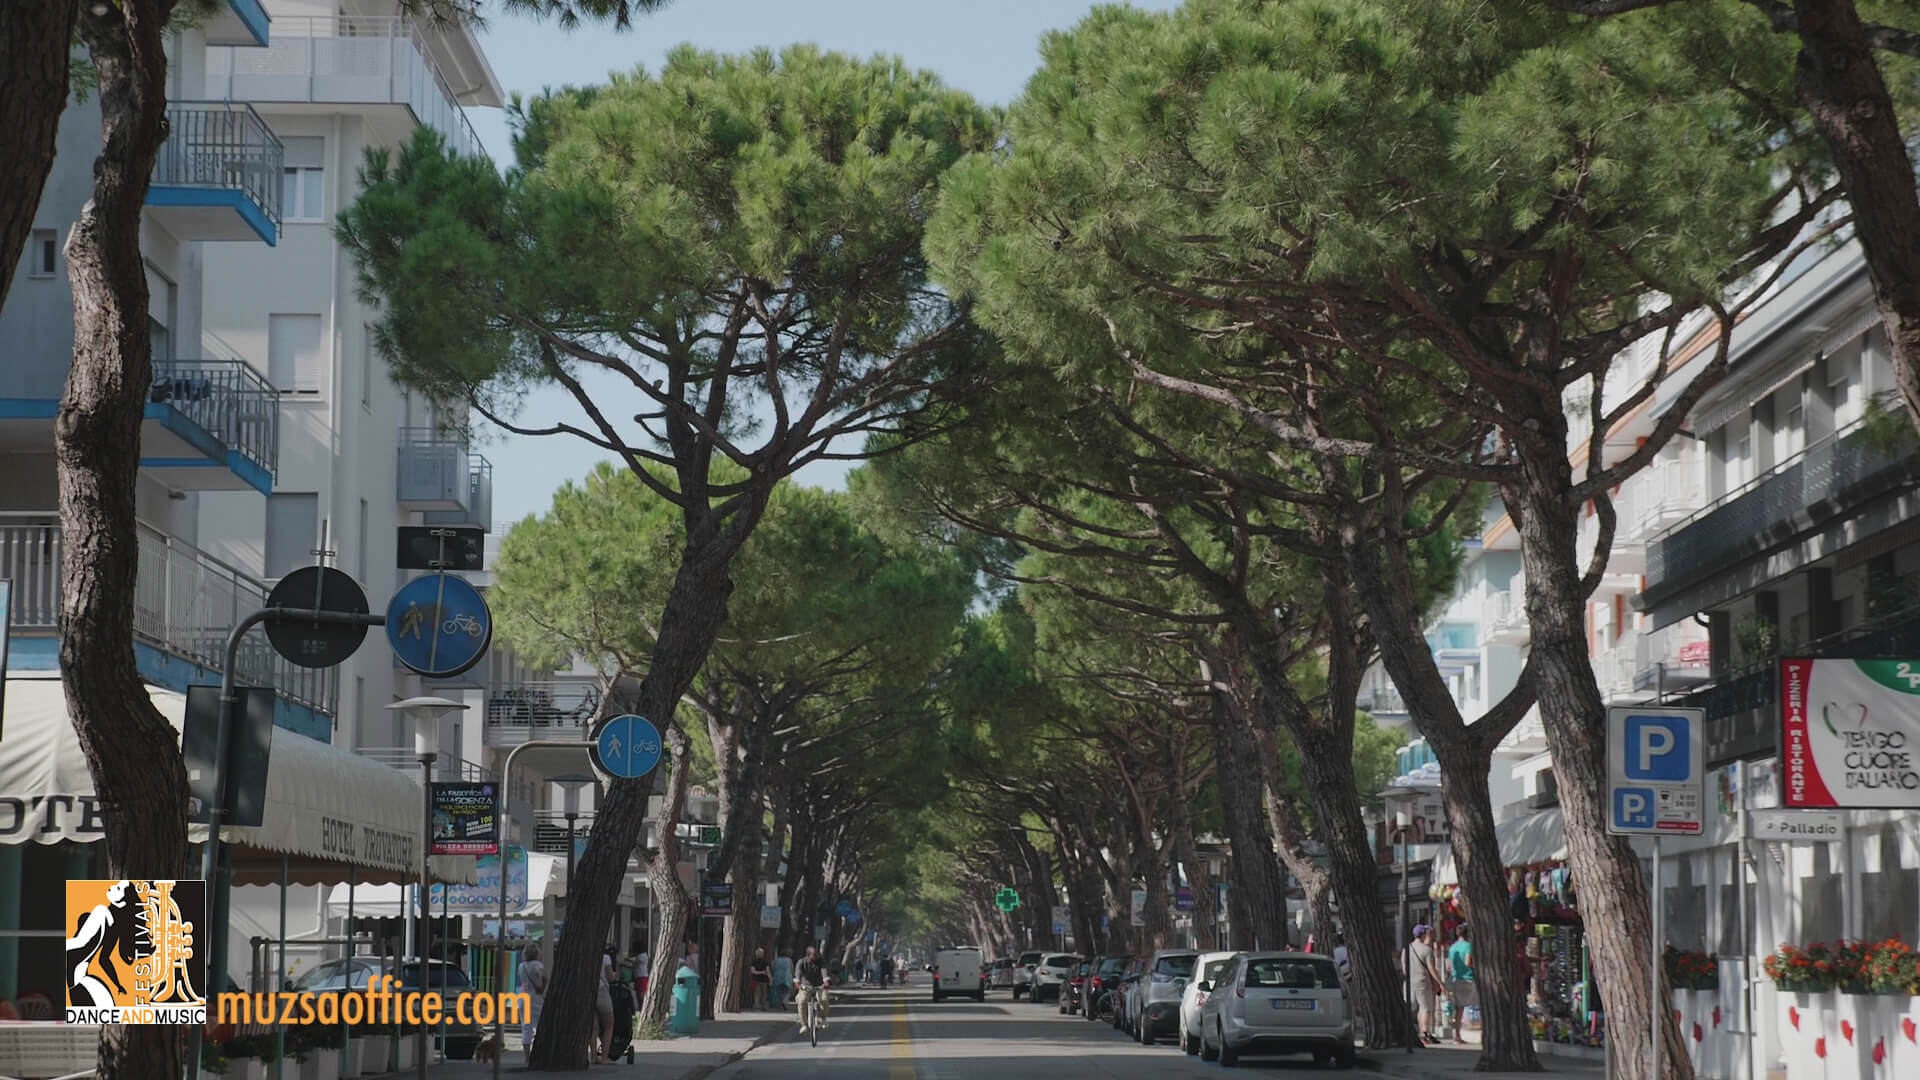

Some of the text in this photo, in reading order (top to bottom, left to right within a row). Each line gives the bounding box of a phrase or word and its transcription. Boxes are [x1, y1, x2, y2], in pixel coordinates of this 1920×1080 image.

[1895, 662, 1911, 678] 2
[1788, 664, 1805, 801] PIZZERIA RISTORANTE
[1842, 730, 1906, 750] TENGO
[1639, 725, 1675, 771] P
[1844, 752, 1911, 769] CUORE
[1845, 771, 1920, 790] ITALIANO
[1623, 794, 1645, 822] P
[322, 816, 356, 857] HOTEL
[1780, 822, 1837, 834] Palladio
